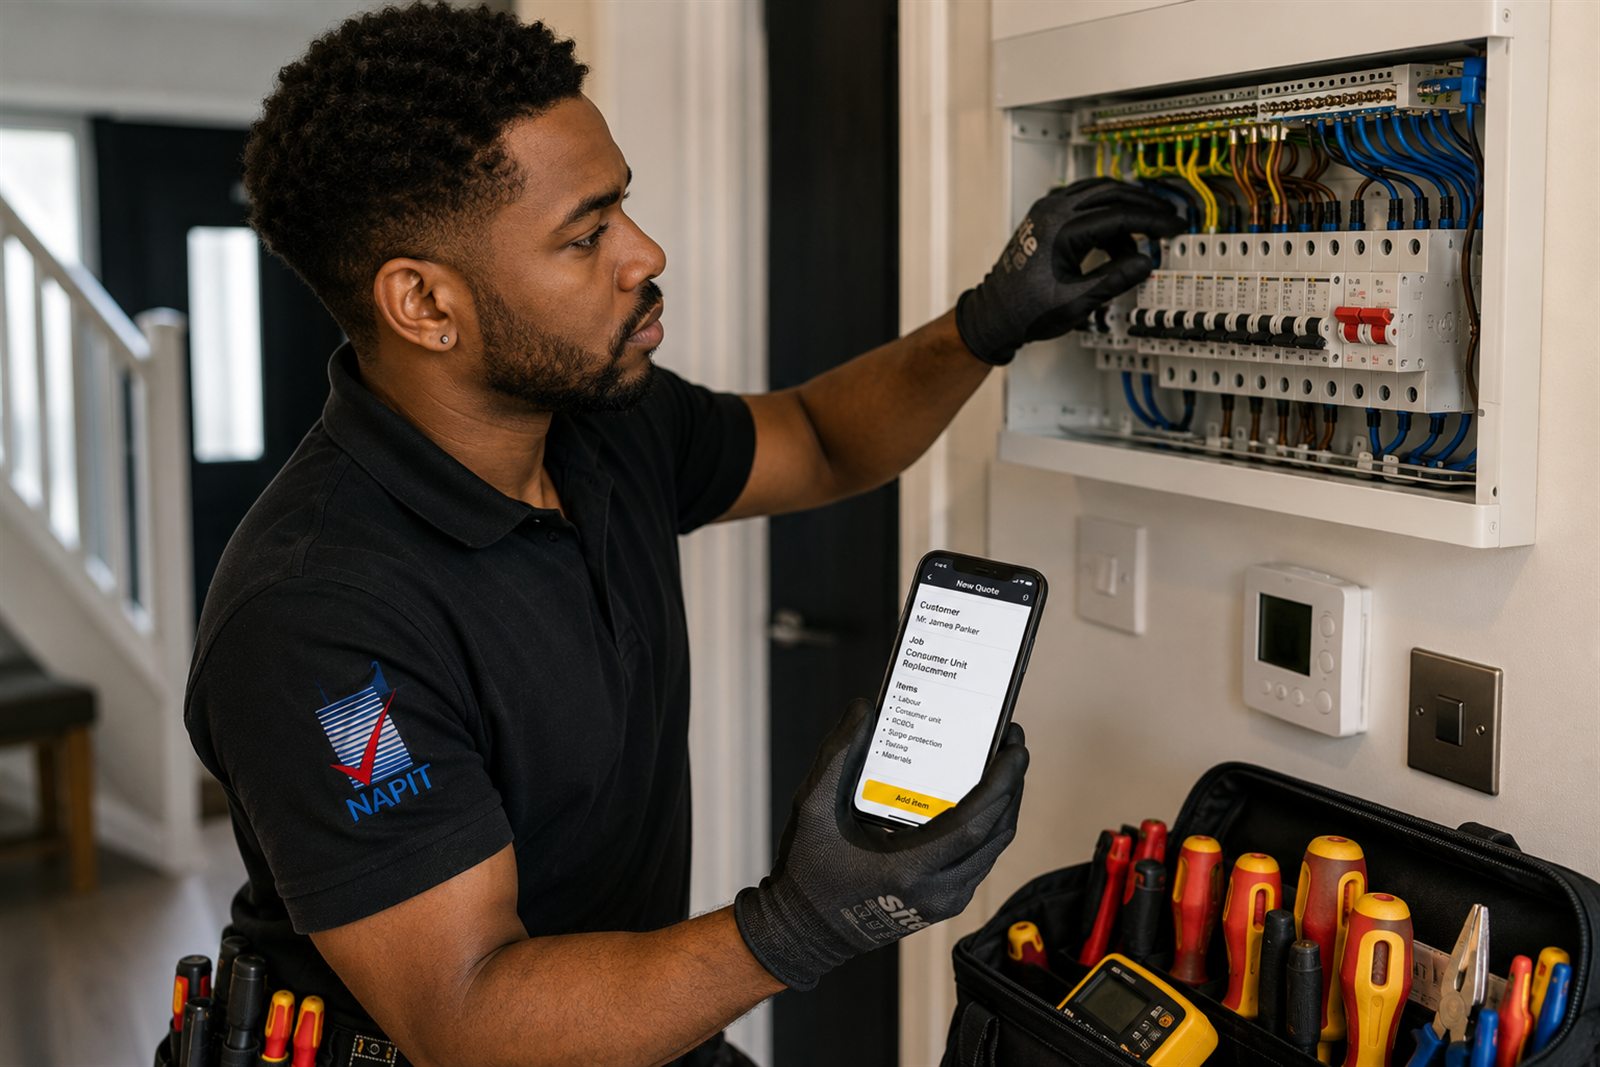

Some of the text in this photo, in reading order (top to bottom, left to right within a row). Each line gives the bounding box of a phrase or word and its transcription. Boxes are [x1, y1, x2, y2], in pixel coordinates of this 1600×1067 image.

[956, 580, 1000, 596] New Quote
[920, 600, 960, 616] Customer
[915, 614, 927, 624] Mr.
[955, 624, 980, 636] Parker
[909, 636, 925, 646] Job
[905, 648, 968, 670] Consumer Unit
[895, 681, 918, 693] Items
[898, 695, 922, 706] Labour
[908, 735, 943, 749] protection
[345, 763, 432, 824] NAPIT
[895, 794, 911, 804] Add
